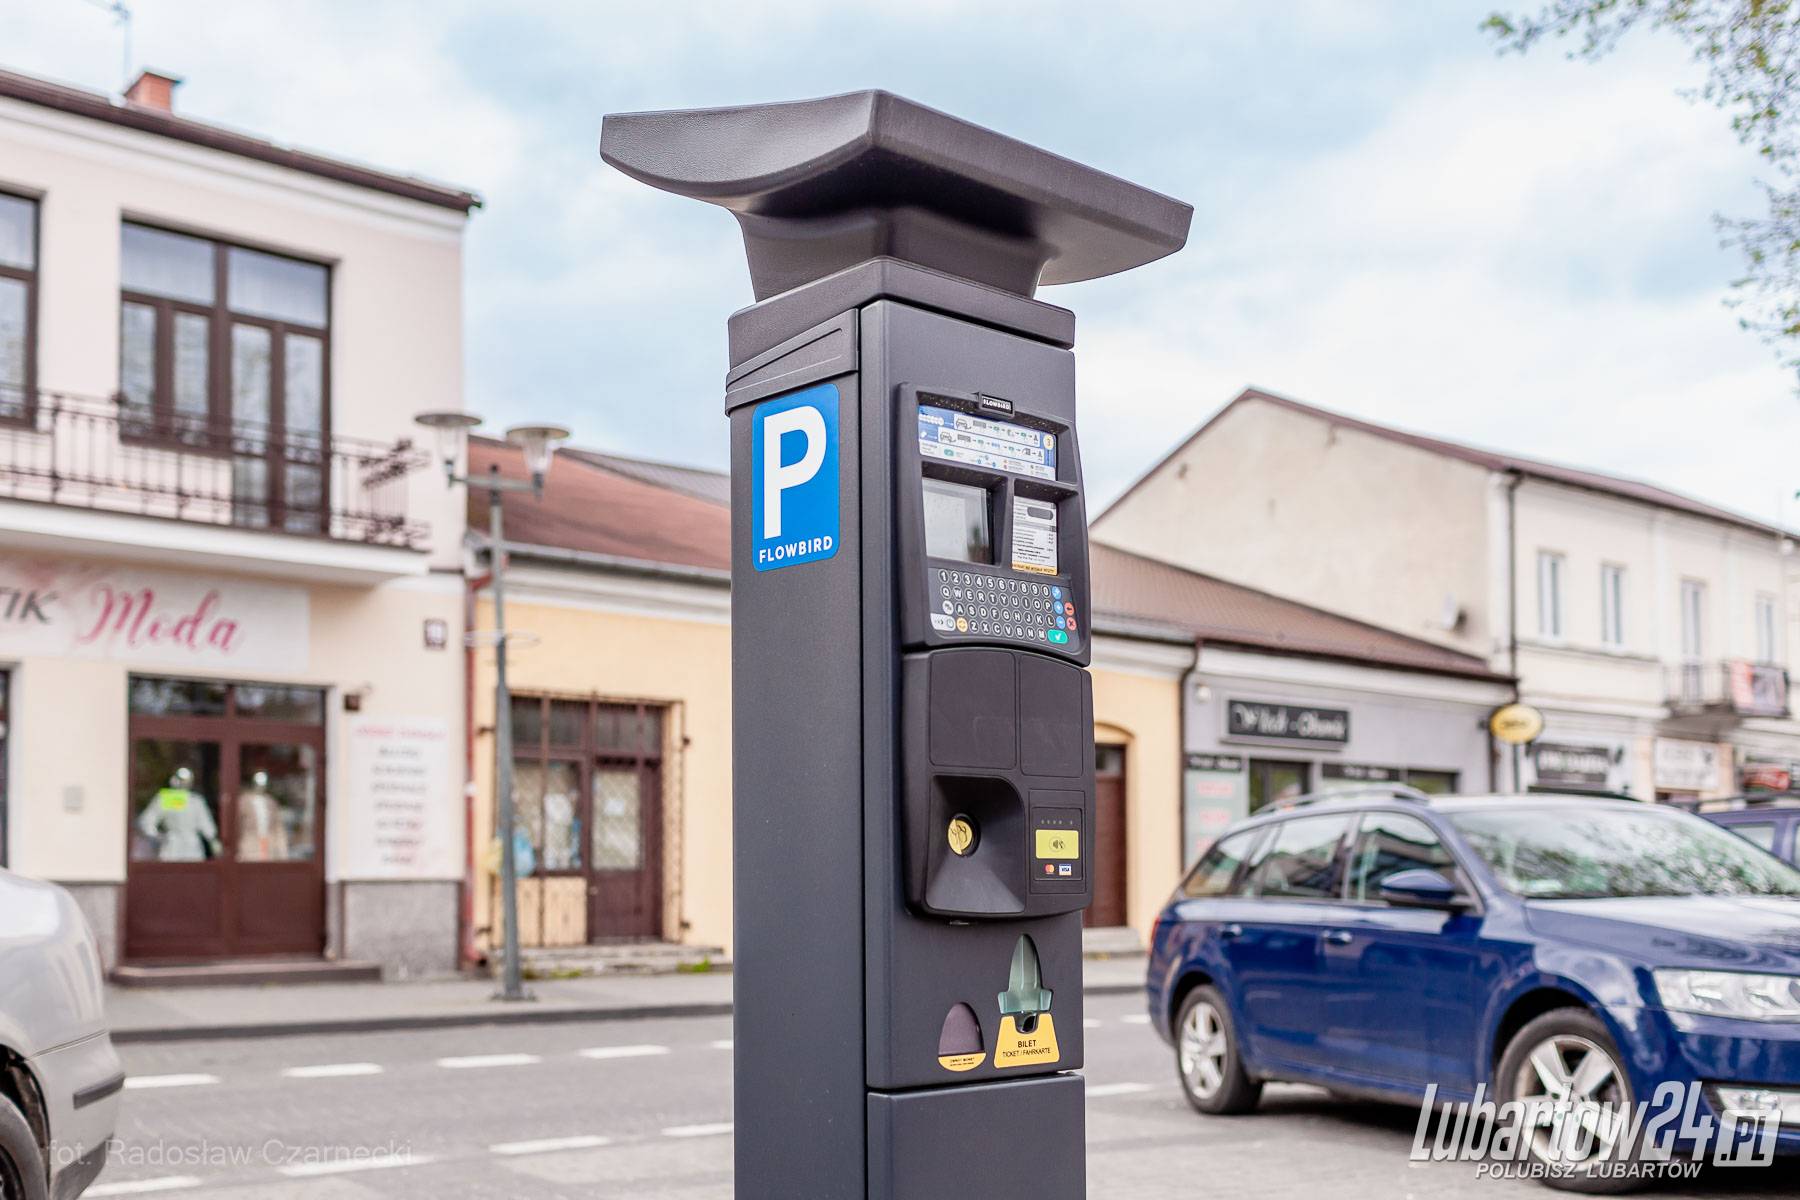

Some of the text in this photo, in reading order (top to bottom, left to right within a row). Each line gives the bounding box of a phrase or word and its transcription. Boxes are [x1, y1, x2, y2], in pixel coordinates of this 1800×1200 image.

[764, 406, 827, 539] P
[759, 536, 833, 564] FLOWBIRD
[78, 583, 240, 651] Moda
[1018, 1040, 1036, 1048] BILET
